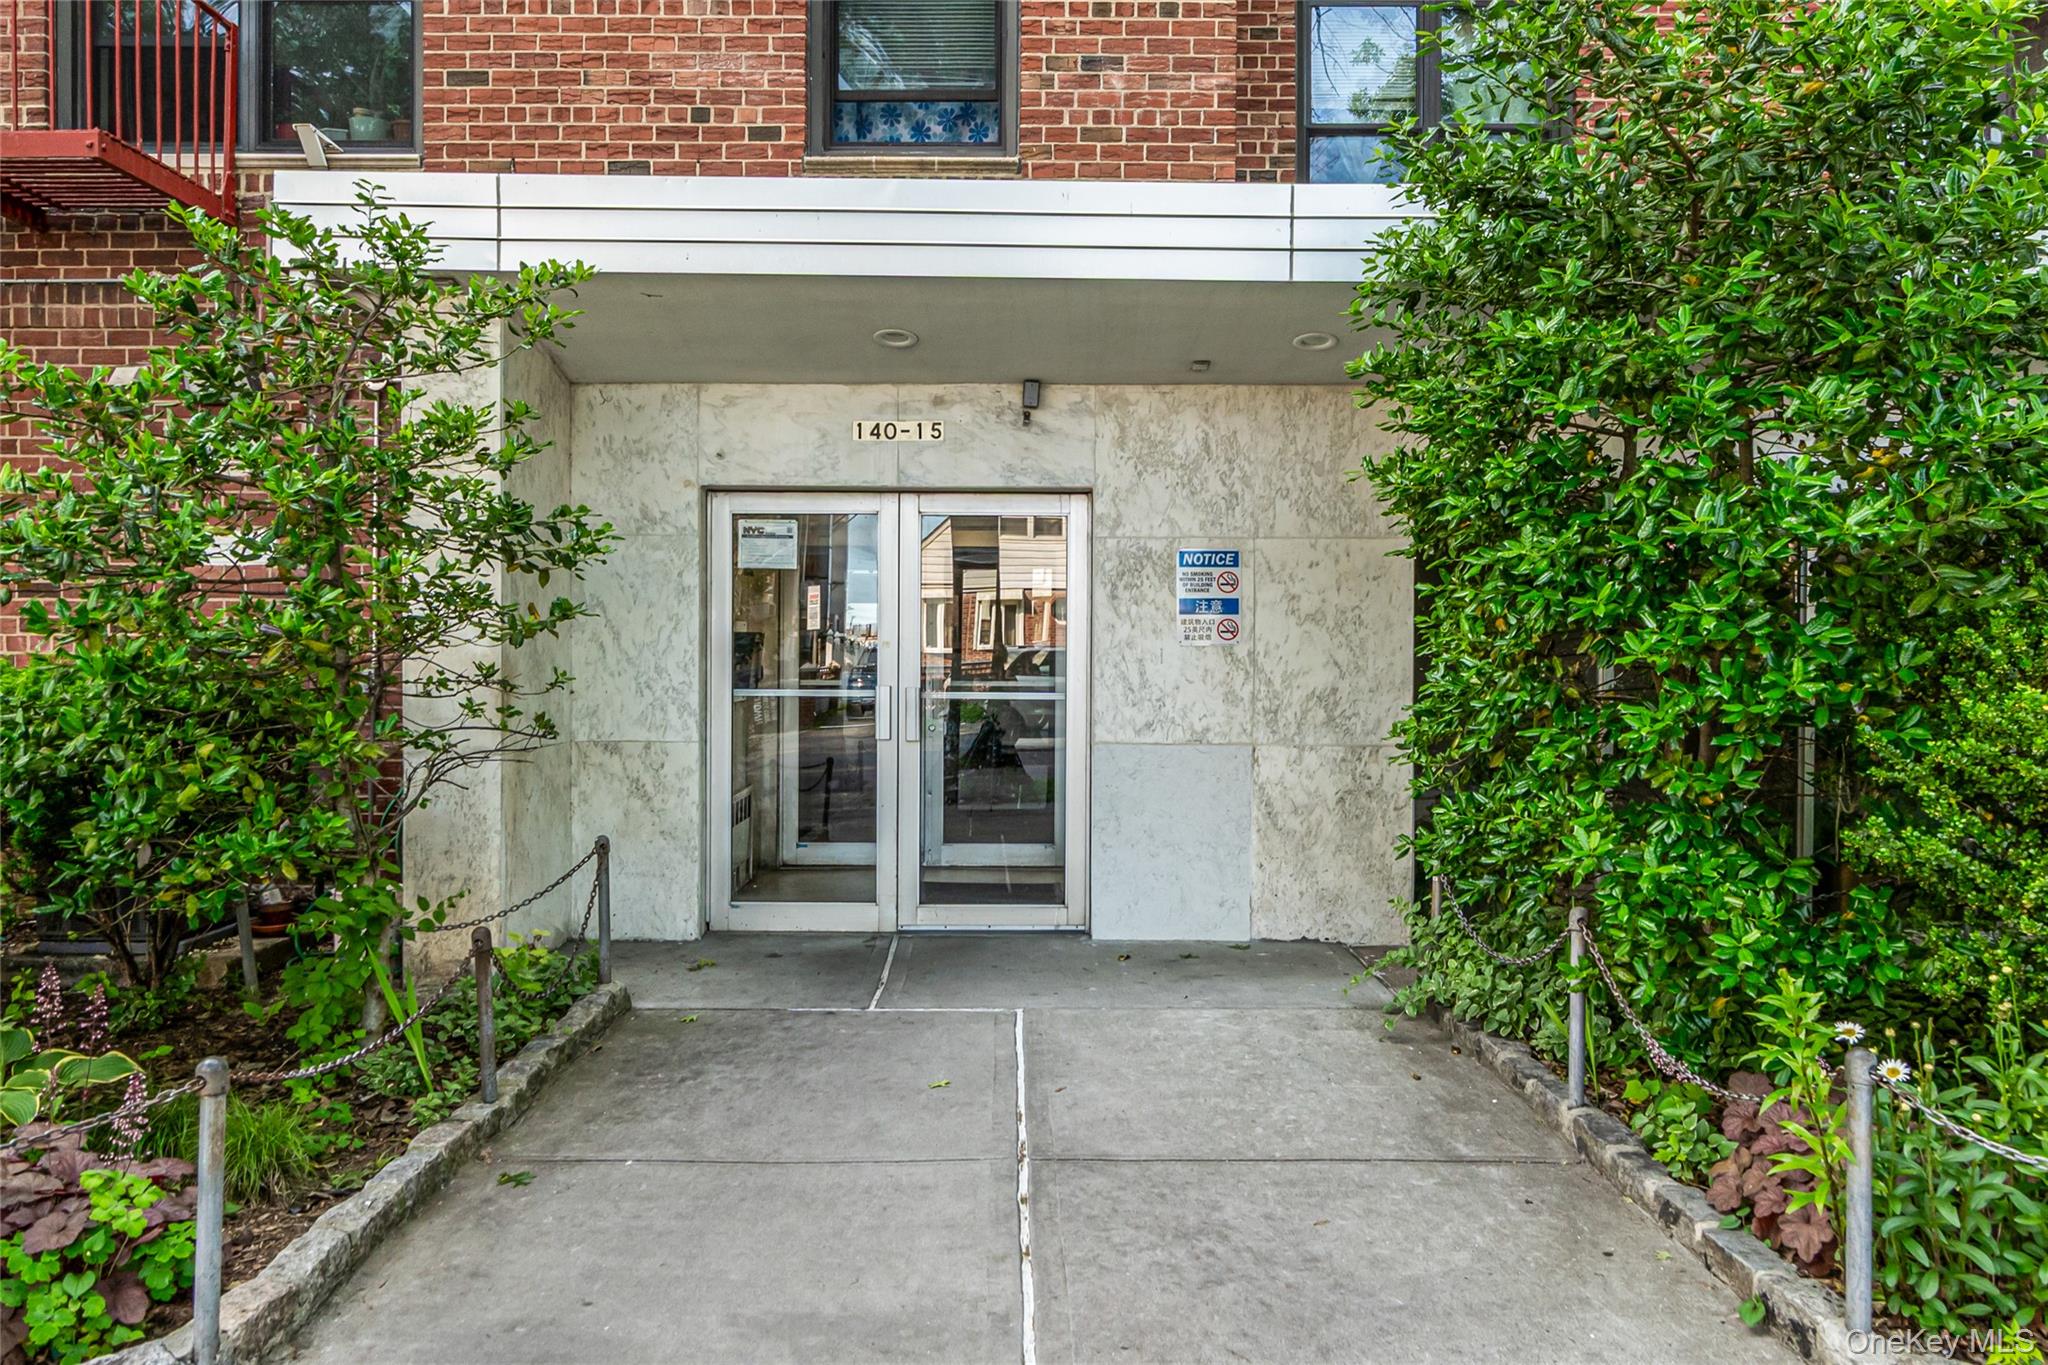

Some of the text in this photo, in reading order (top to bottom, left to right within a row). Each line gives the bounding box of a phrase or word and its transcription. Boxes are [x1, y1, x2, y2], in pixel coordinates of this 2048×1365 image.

[856, 421, 942, 440] 140-15
[743, 526, 765, 534] NYC
[1182, 553, 1235, 566] NOTICE
[1195, 600, 1223, 614] 注意
